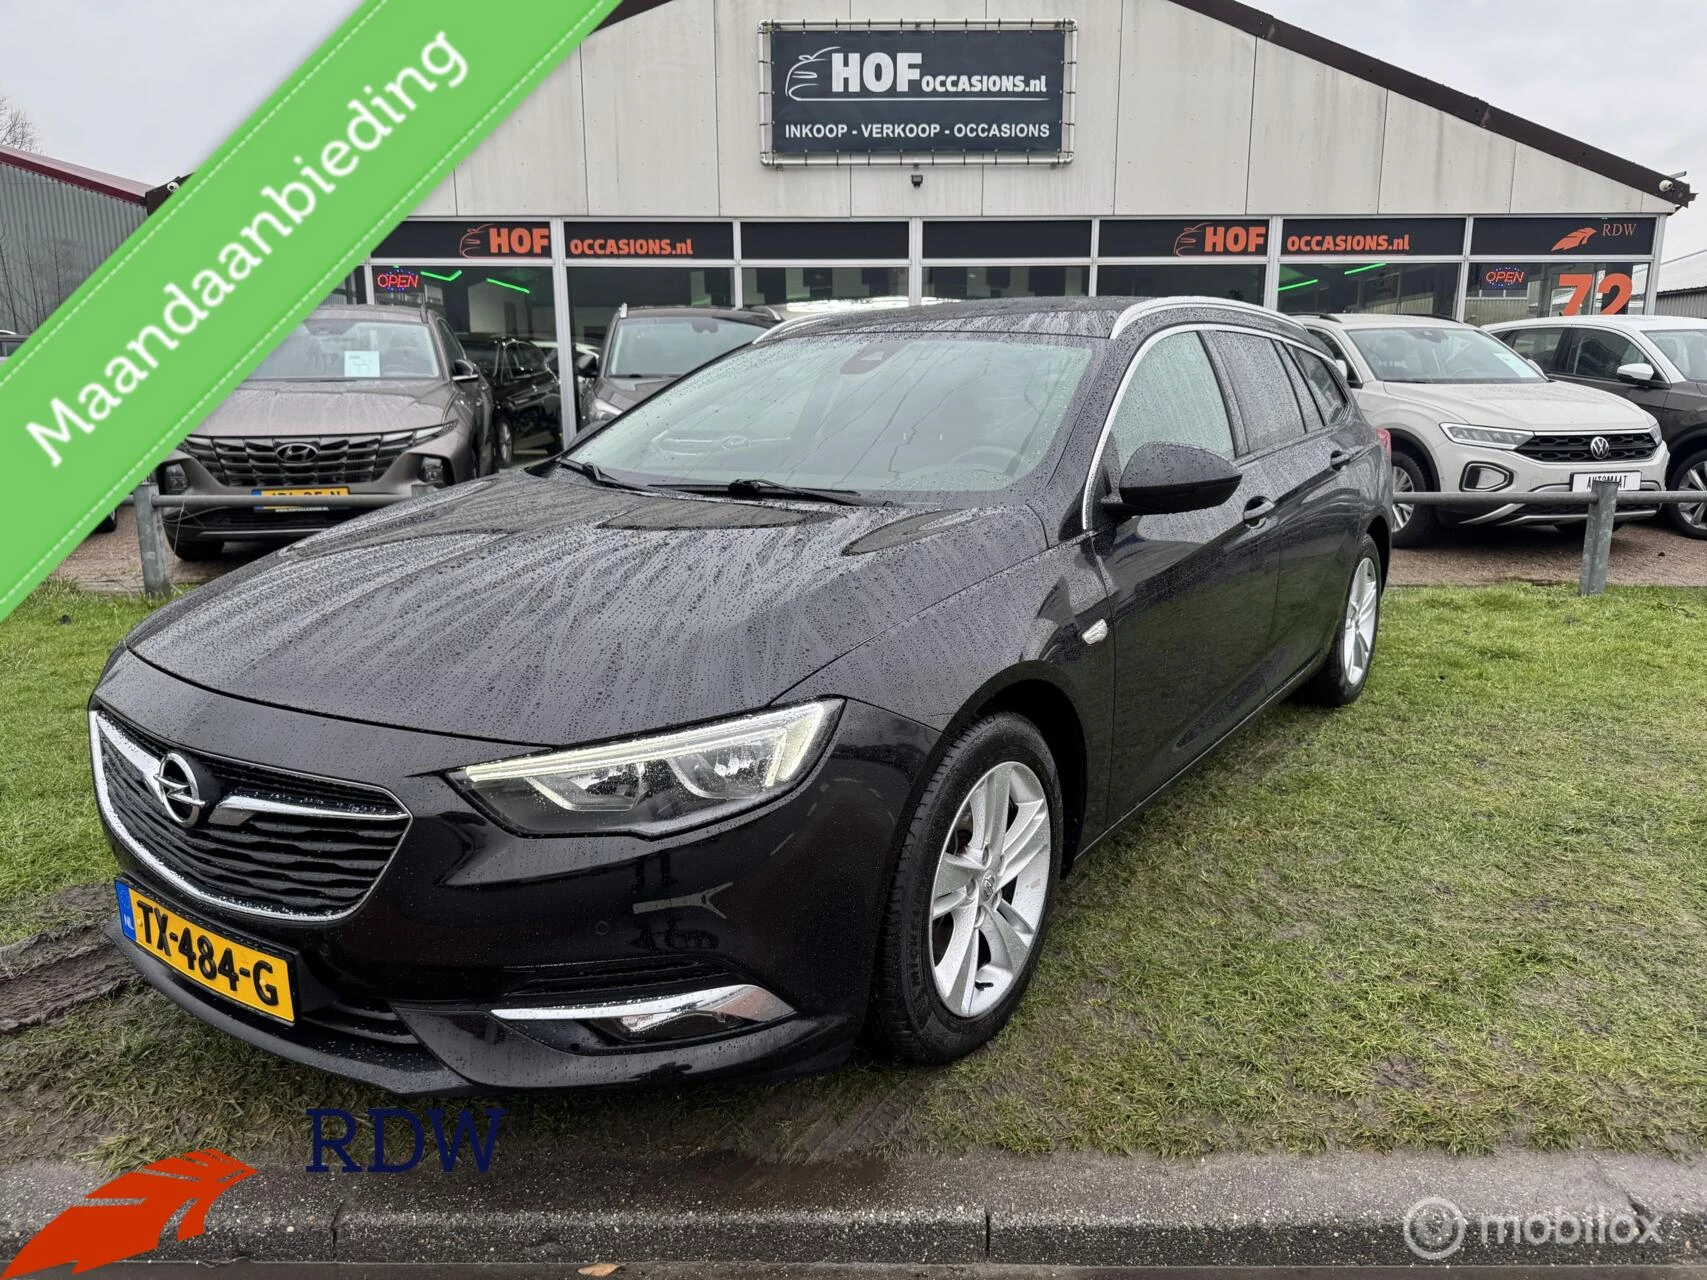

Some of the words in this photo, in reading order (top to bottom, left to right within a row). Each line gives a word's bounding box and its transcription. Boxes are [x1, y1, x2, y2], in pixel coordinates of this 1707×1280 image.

[785, 124, 848, 138] INKOOP
[861, 124, 940, 138] VERKOOP
[953, 123, 1050, 138] OCCASIONS
[1602, 223, 1637, 237] RDW
[489, 227, 549, 254] HOF
[570, 239, 693, 255] OCCASIONS.nl
[1204, 226, 1266, 253] HOF
[1286, 234, 1410, 251] OCCASIONS.nl
[377, 273, 419, 289] OPEN
[1485, 271, 1525, 284] OPEN
[1559, 272, 1633, 317] 72
[123, 914, 134, 930] NL
[136, 900, 280, 1007] TX-484-G
